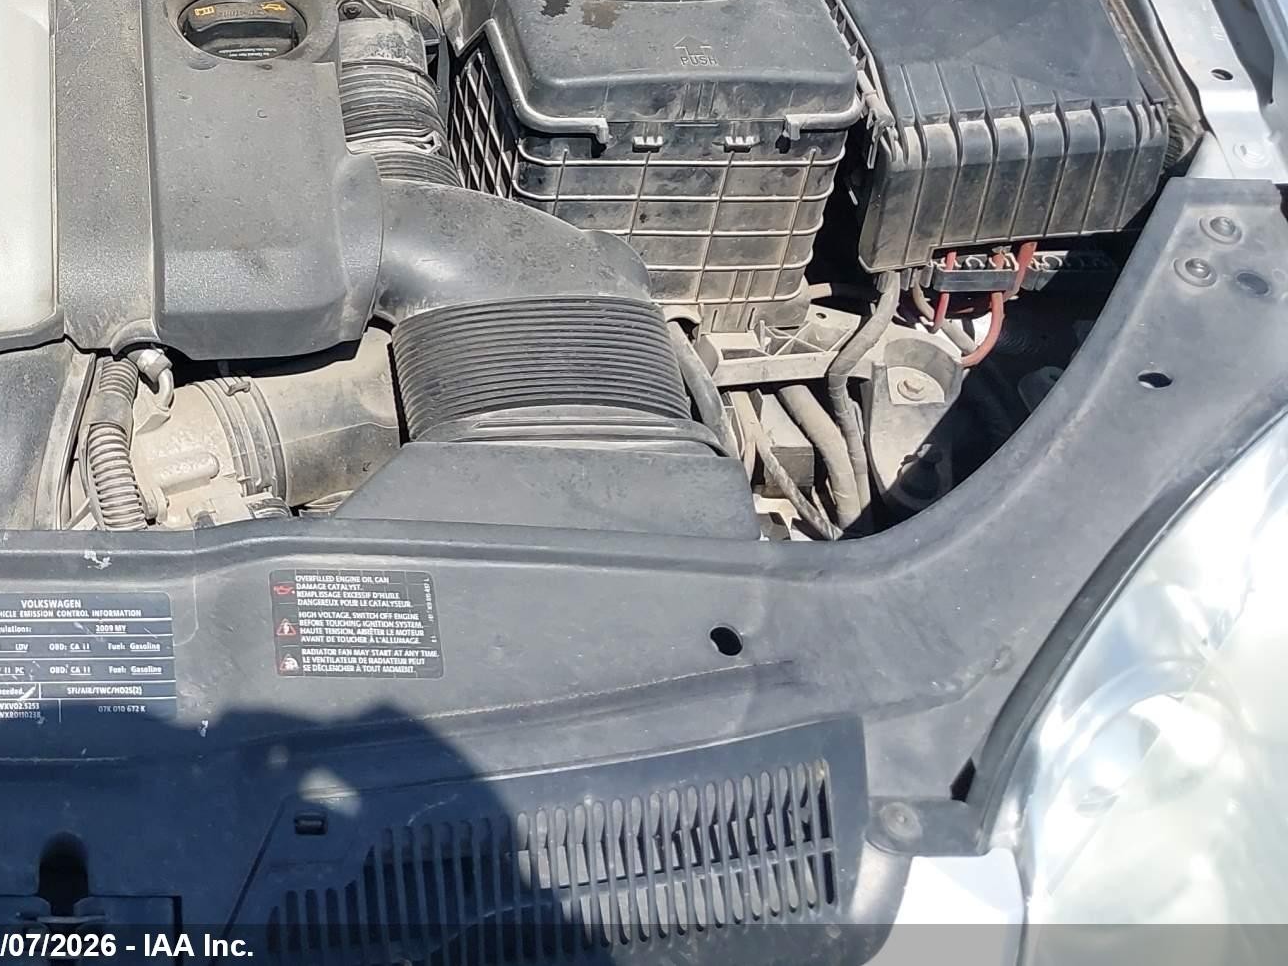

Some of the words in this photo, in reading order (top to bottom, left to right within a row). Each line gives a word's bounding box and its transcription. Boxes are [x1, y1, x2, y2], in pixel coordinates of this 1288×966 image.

[680, 56, 719, 66] PUSH
[336, 575, 360, 583] ENGINE
[327, 583, 363, 591] CATALYST.
[296, 590, 341, 598] REMPLISSAGE
[343, 591, 371, 599] EXCESSIF
[373, 592, 400, 600] D'HUILE
[21, 600, 81, 608] VOLKSWAGEN
[297, 598, 339, 606] DANGEREUX
[340, 599, 359, 607] POUR
[368, 600, 413, 608] CATALYSEUR.
[20, 610, 54, 618] EMISSION
[380, 612, 393, 620] OFF
[299, 619, 324, 627] BEFORE
[129, 642, 161, 650] Gasoline
[337, 648, 352, 656] FAN
[420, 650, 440, 658] TIME.
[108, 666, 127, 674] Fuel:
[130, 665, 162, 674] Gasoline
